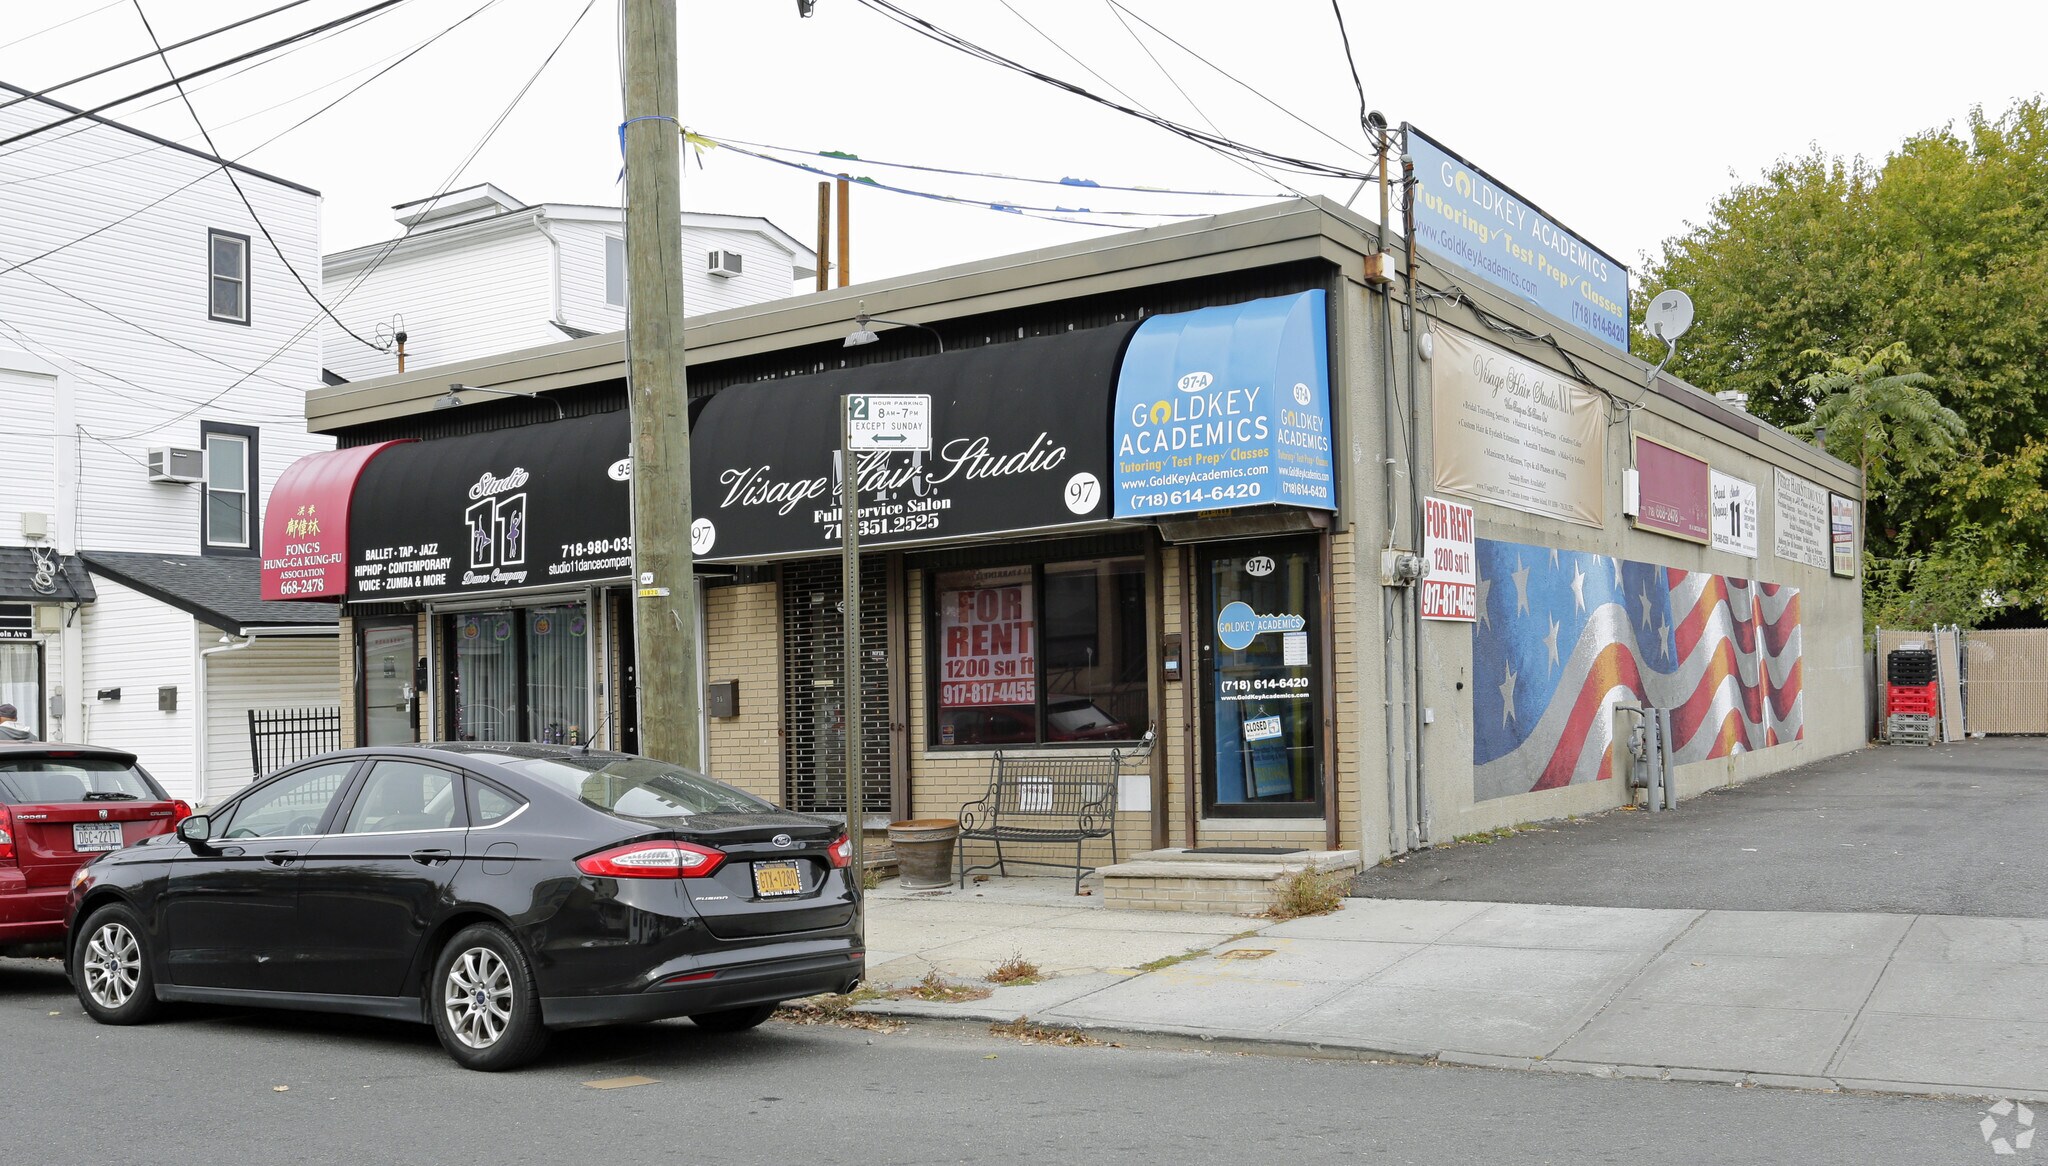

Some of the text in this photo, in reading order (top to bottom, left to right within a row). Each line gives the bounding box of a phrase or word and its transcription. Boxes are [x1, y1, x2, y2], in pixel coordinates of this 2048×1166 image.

[1441, 161, 1608, 282] GOLDKEY ACADEMICS
[1414, 219, 1538, 297] www.GoldKeyAcademics.com
[1416, 183, 1623, 318] Tutoring Test Prep Classes
[1571, 300, 1625, 344] (718) 614-6420
[1183, 375, 1208, 389] 97-A
[1295, 386, 1309, 402] 97-A
[1473, 354, 1504, 399] Visage
[1506, 366, 1531, 399] Hair
[1533, 381, 1559, 410] Studio
[853, 397, 866, 418] 2
[1131, 387, 1261, 428] GOLDKEY
[856, 422, 923, 431] EXCEPT SUNDAY
[1281, 408, 1324, 433] GOLDKEY
[1119, 416, 1268, 457] ACADEMICS
[1277, 428, 1328, 452] ACADEMICS
[617, 463, 631, 477] 95
[1120, 448, 1269, 474] Tutoring Test Prep Classes
[468, 467, 530, 500] Studio
[720, 432, 1067, 516] Visage Hair Studio
[1121, 465, 1269, 490] www.GoldKeyAcademics.com
[1070, 481, 1095, 505] 97
[1131, 482, 1261, 509] (718) 614-6420
[1296, 483, 1327, 498] 614-6420
[814, 497, 951, 524] Full ervice Salon
[1426, 499, 1472, 544] FOR RENT
[1730, 500, 1741, 538] 11
[465, 492, 527, 569] 11
[692, 526, 711, 546] 97
[823, 513, 939, 540] 71351.2525
[285, 542, 320, 556] FONG'S
[365, 543, 438, 561] BALLET TAP JAZZ
[561, 536, 633, 558] 718-980-035
[263, 553, 342, 570] HUNG-GA KUNG-FU
[355, 557, 452, 577] HIPHOP CONTEMPORARY
[1248, 559, 1273, 573] 97-A
[1434, 547, 1470, 575] 1200 sq ft
[280, 568, 325, 579] ASSOCIATION
[358, 573, 446, 592] VOICE ZUMBA & MORE
[461, 567, 528, 585] Dance Company
[280, 578, 324, 595] 668-2478
[958, 588, 1022, 624] FOR
[1424, 582, 1475, 617] 917-817-4455
[13, 630, 28, 638] Ave
[1219, 618, 1300, 633] GOLDKEY ACADEMICS
[947, 621, 1034, 658] RENT
[945, 656, 1034, 679] 1200 sq ft
[943, 681, 1034, 705] 917-817-4455
[1221, 677, 1309, 693] (718) 614-6420
[1221, 692, 1310, 701] www.GoldKeyAcademics.com
[1246, 720, 1267, 733] CLOSED
